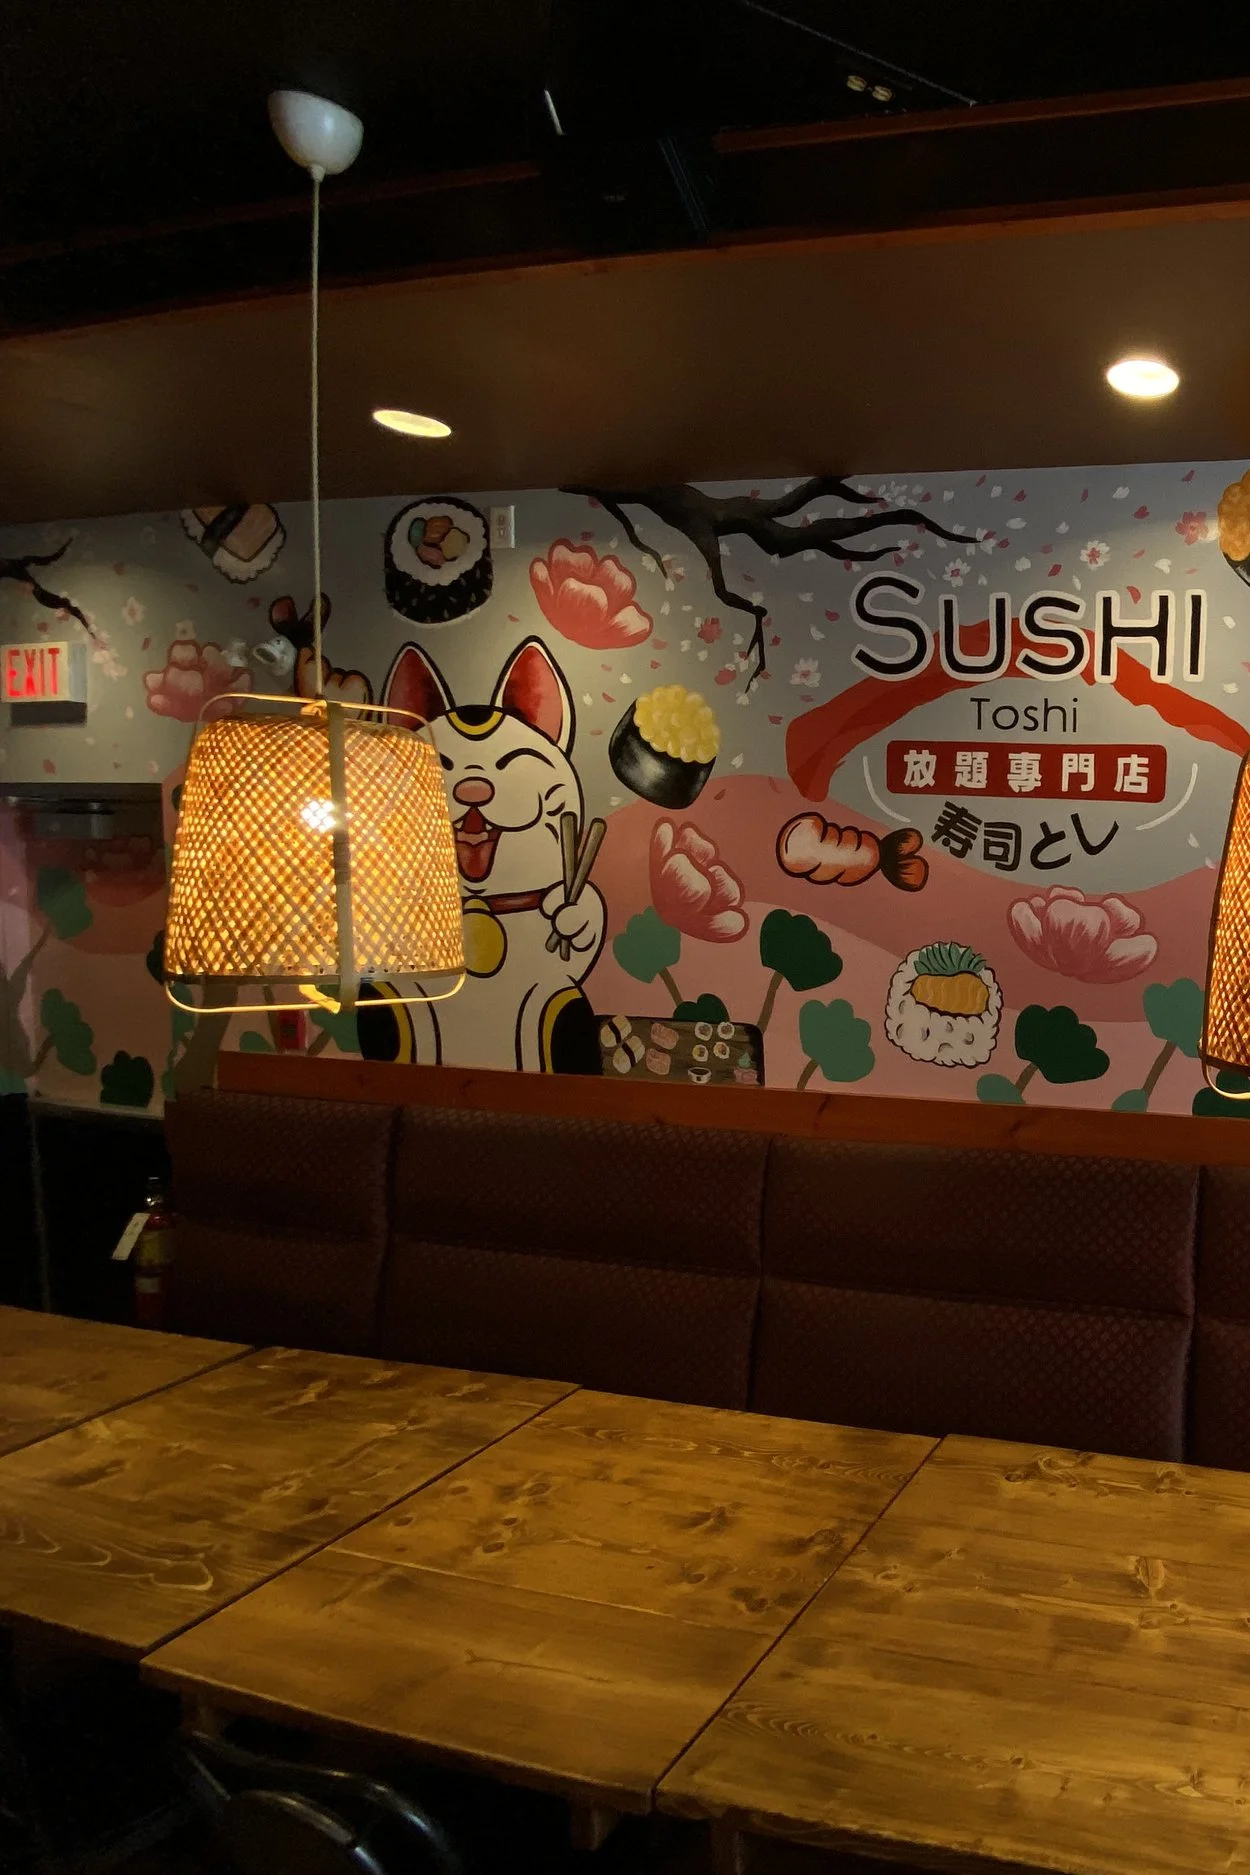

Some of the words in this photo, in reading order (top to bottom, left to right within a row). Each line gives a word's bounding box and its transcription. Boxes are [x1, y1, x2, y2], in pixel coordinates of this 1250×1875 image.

[854, 574, 1204, 679] SUSHI
[7, 647, 60, 697] EXIT
[970, 697, 1078, 733] Toshi
